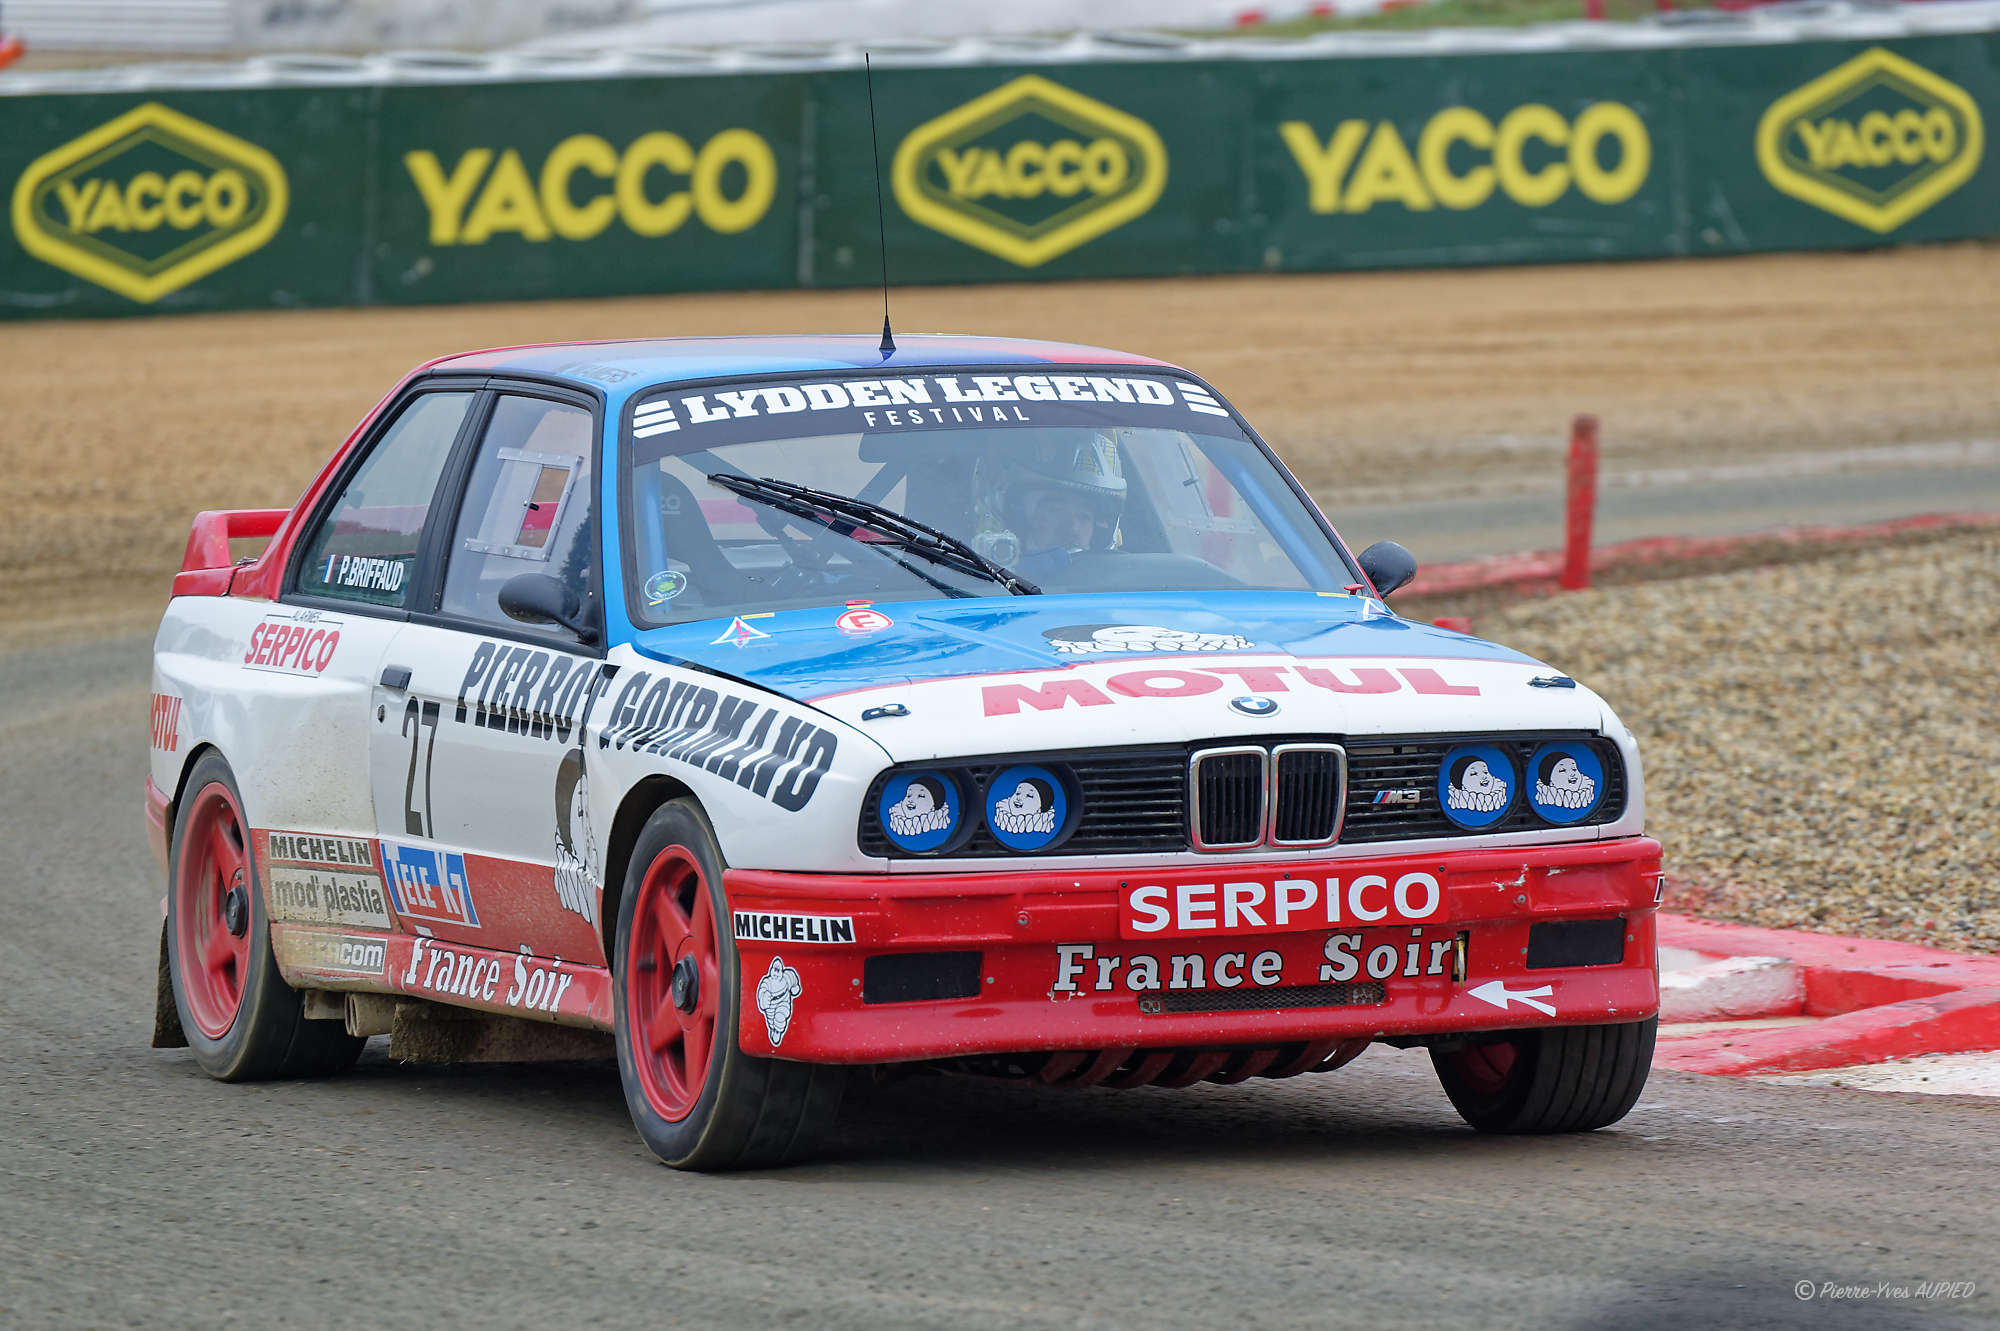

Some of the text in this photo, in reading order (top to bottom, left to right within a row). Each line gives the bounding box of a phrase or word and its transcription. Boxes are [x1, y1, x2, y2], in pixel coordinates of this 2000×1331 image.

[936, 138, 1129, 199] YACCO
[1279, 101, 1651, 213] YACCO
[1796, 107, 1955, 170] YACCO
[57, 169, 249, 233] YACCO
[404, 129, 778, 246] YACCO
[681, 375, 1175, 424] LYDDEN LEGEND
[864, 406, 1031, 427] FESTIVAL
[336, 555, 404, 591] P.BRIFFAUD
[244, 622, 340, 672] SERPICO
[455, 641, 621, 744] PIERROT
[982, 666, 1481, 717] MOTUL
[402, 696, 440, 839] 27
[599, 671, 838, 812] GOURMAND
[1384, 789, 1420, 804] M3
[270, 836, 371, 865] MICHELIN
[433, 850, 471, 923] K7
[1129, 872, 1440, 932] SERPICO
[735, 914, 853, 941] MICHELIN
[405, 924, 573, 1022] France Soir
[1052, 927, 1452, 992] France Soir
